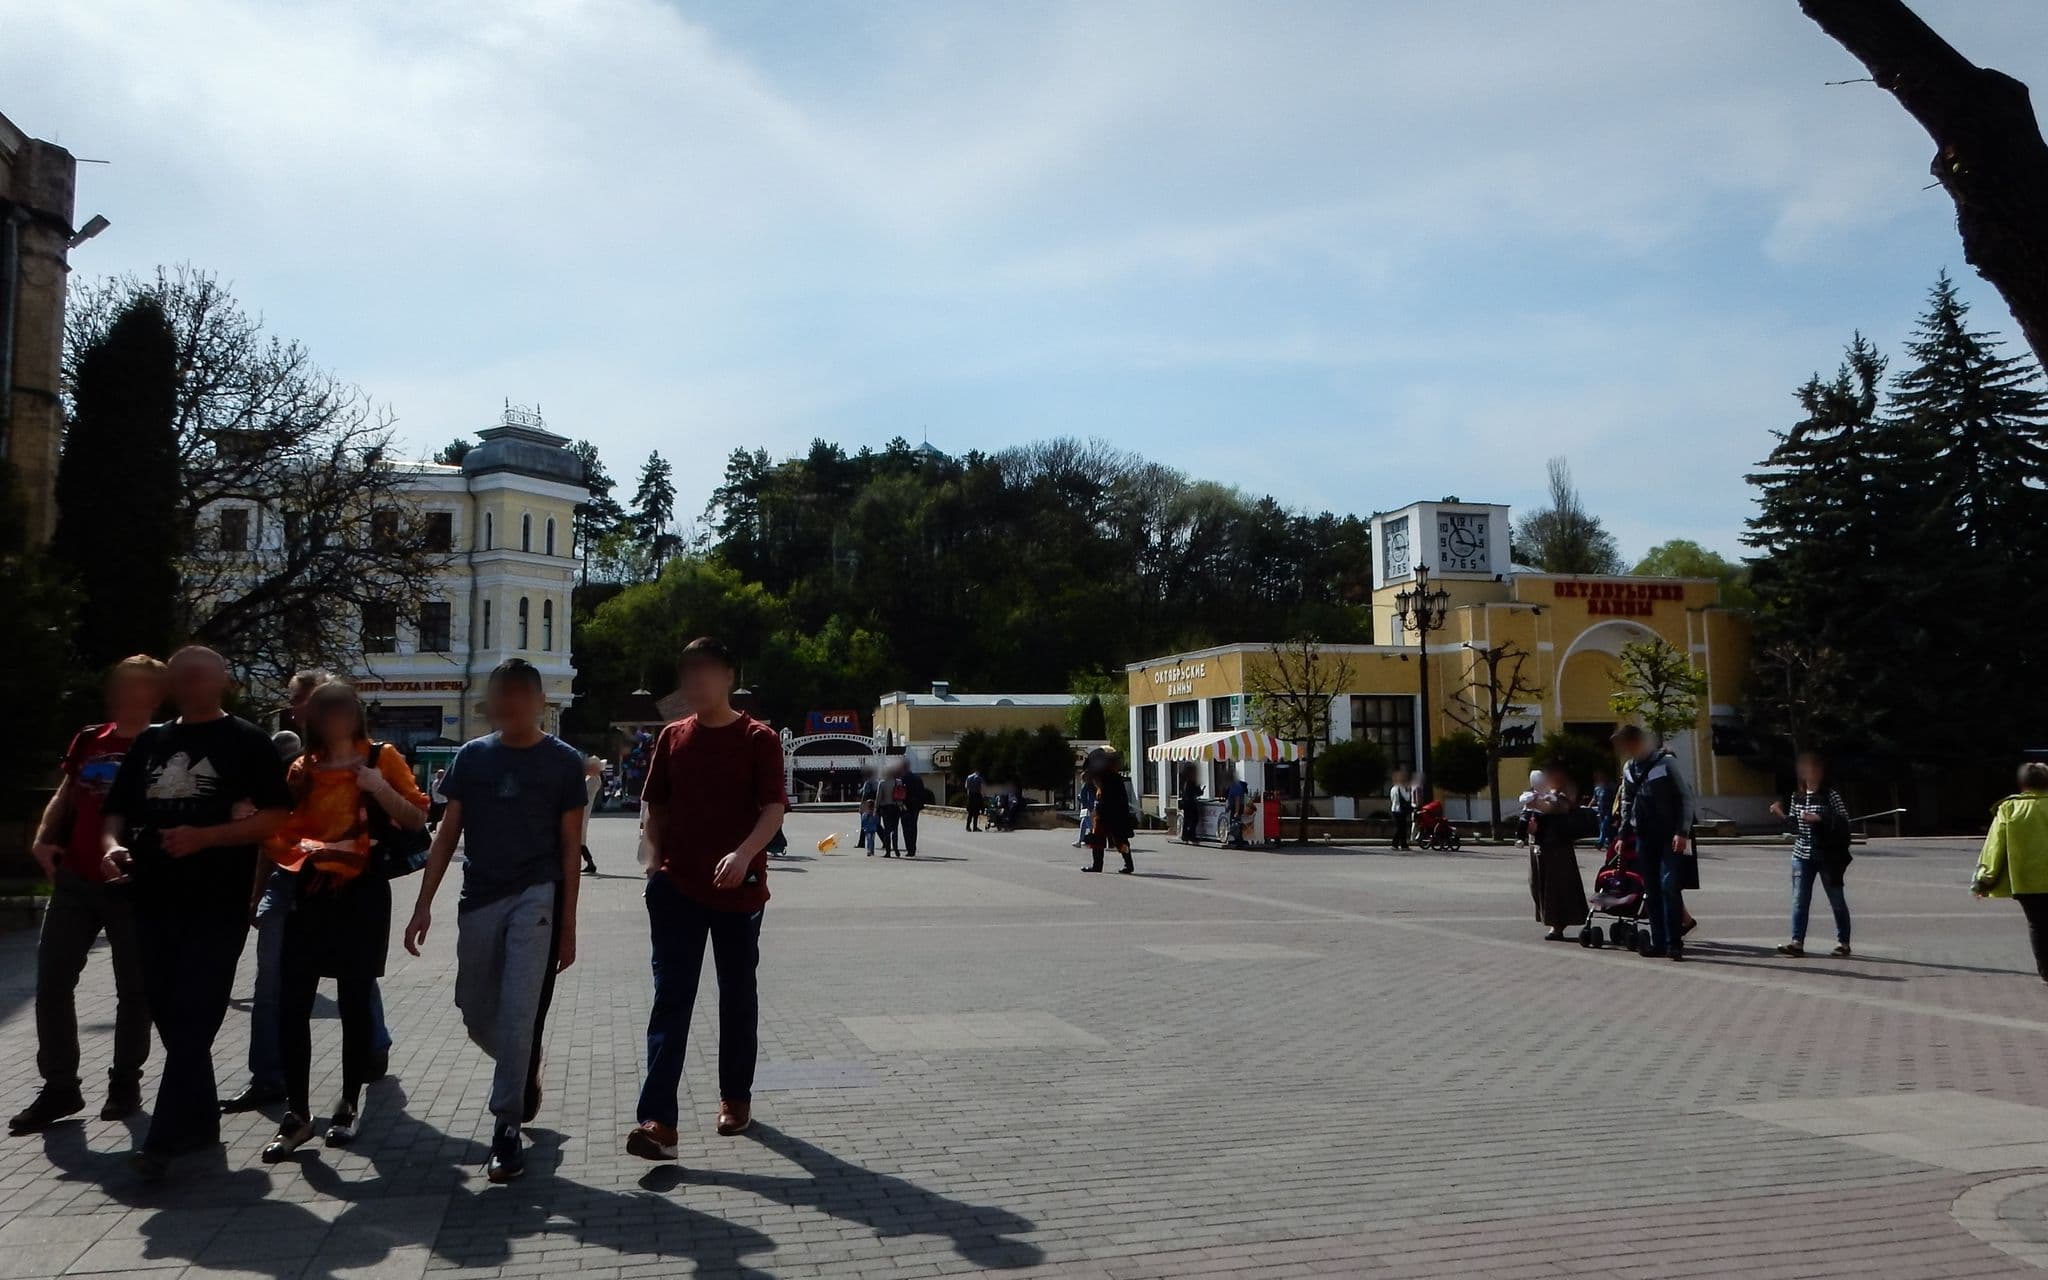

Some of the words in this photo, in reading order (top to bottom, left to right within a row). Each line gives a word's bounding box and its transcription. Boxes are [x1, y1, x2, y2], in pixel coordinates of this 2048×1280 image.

[1554, 582, 1683, 600] ОКТЯБРЬСКИЕ
[1588, 599, 1653, 616] ВАННЫ
[1154, 663, 1206, 685] ОКТЯБРЬСКИЕ
[384, 682, 421, 692] СЛУХА
[424, 682, 432, 691] И
[1168, 681, 1193, 697] ВАННЫ
